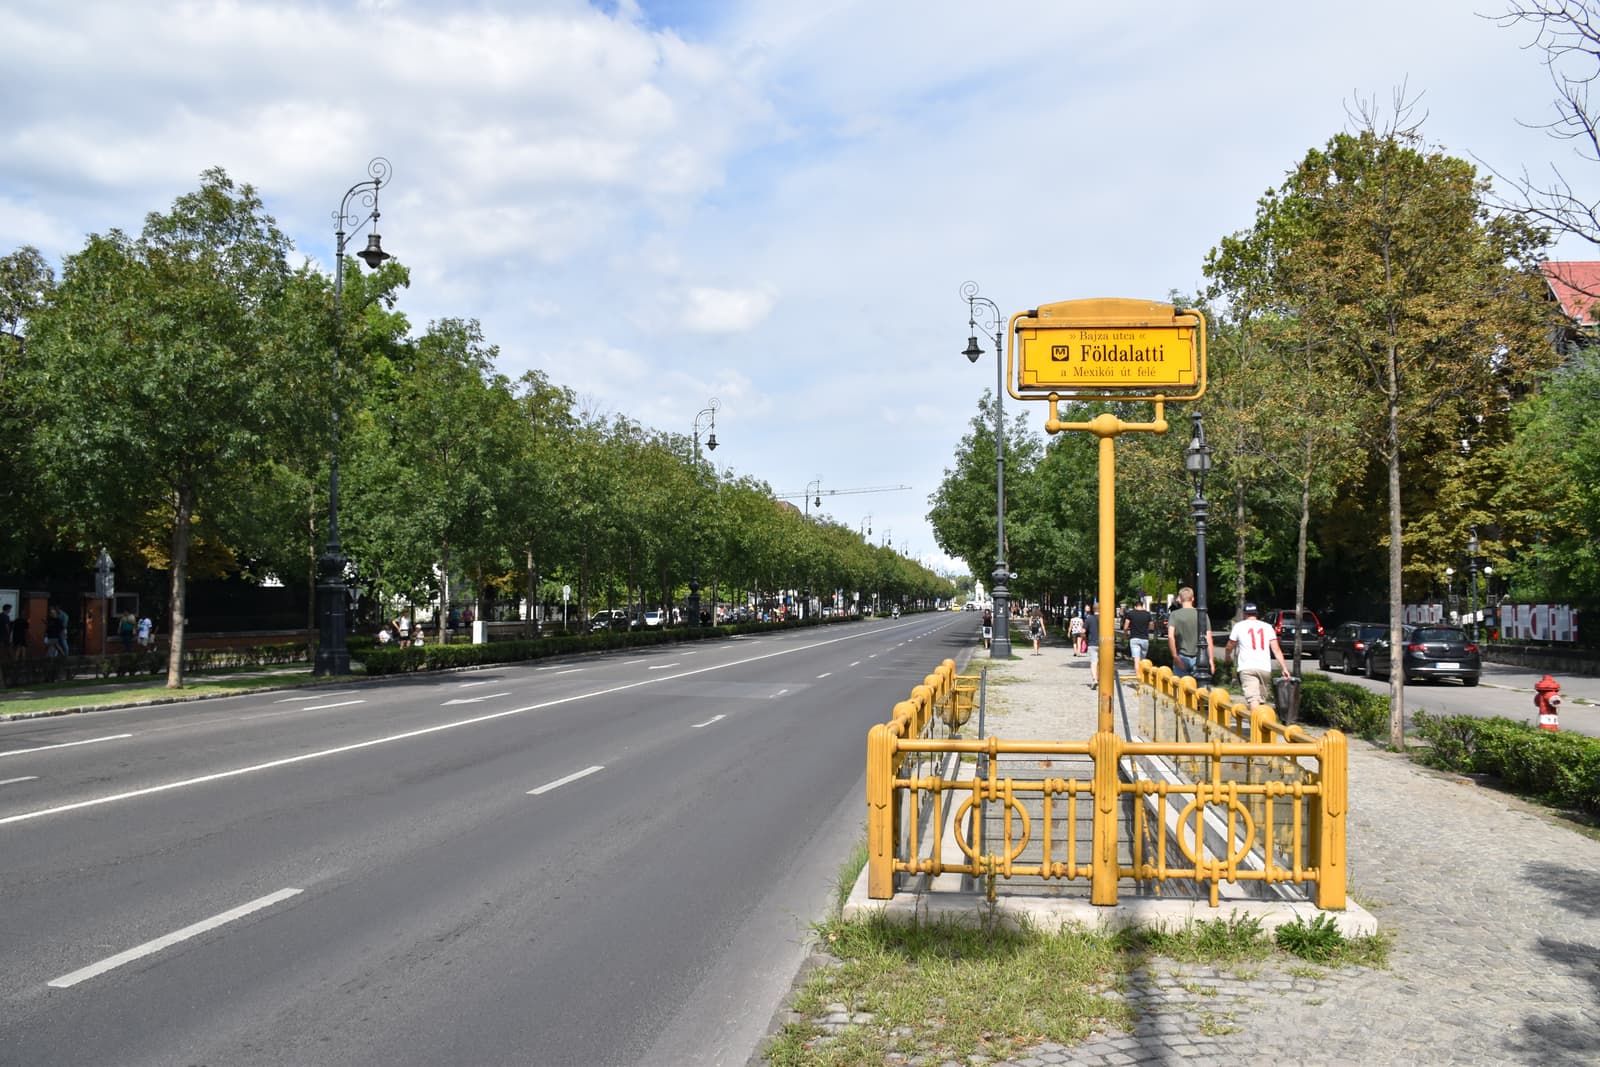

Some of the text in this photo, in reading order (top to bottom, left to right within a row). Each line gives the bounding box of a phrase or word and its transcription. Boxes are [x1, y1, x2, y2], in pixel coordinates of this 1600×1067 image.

[1080, 331, 1135, 341] Bajza utca
[1081, 345, 1164, 362] Földalatti
[1061, 366, 1156, 377] a Mexikói út felé
[1248, 628, 1265, 650] 11
